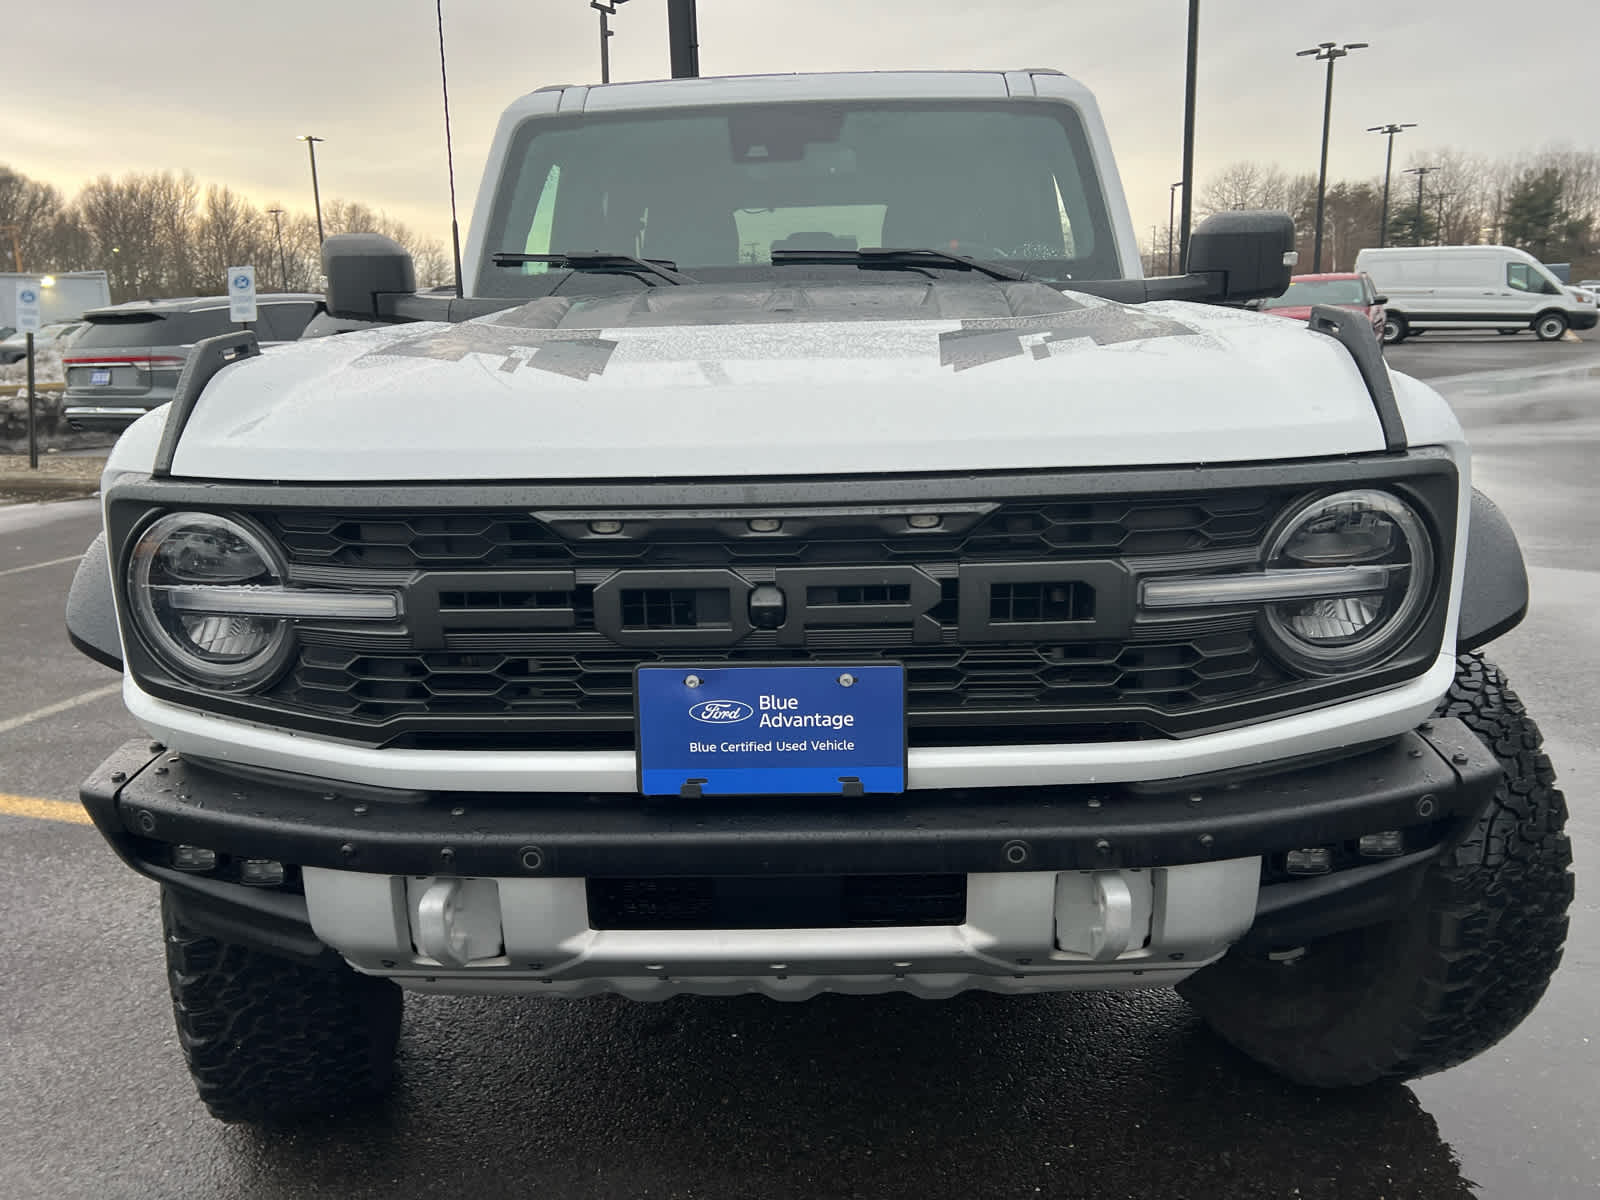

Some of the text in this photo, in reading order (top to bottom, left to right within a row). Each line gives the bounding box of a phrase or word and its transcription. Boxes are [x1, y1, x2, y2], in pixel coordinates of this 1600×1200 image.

[404, 559, 1137, 651] FORD
[759, 695, 798, 710] Blue
[700, 703, 742, 720] Ford
[758, 713, 854, 730] Advantage
[689, 739, 855, 752] Blue Certified Used Vehicle
